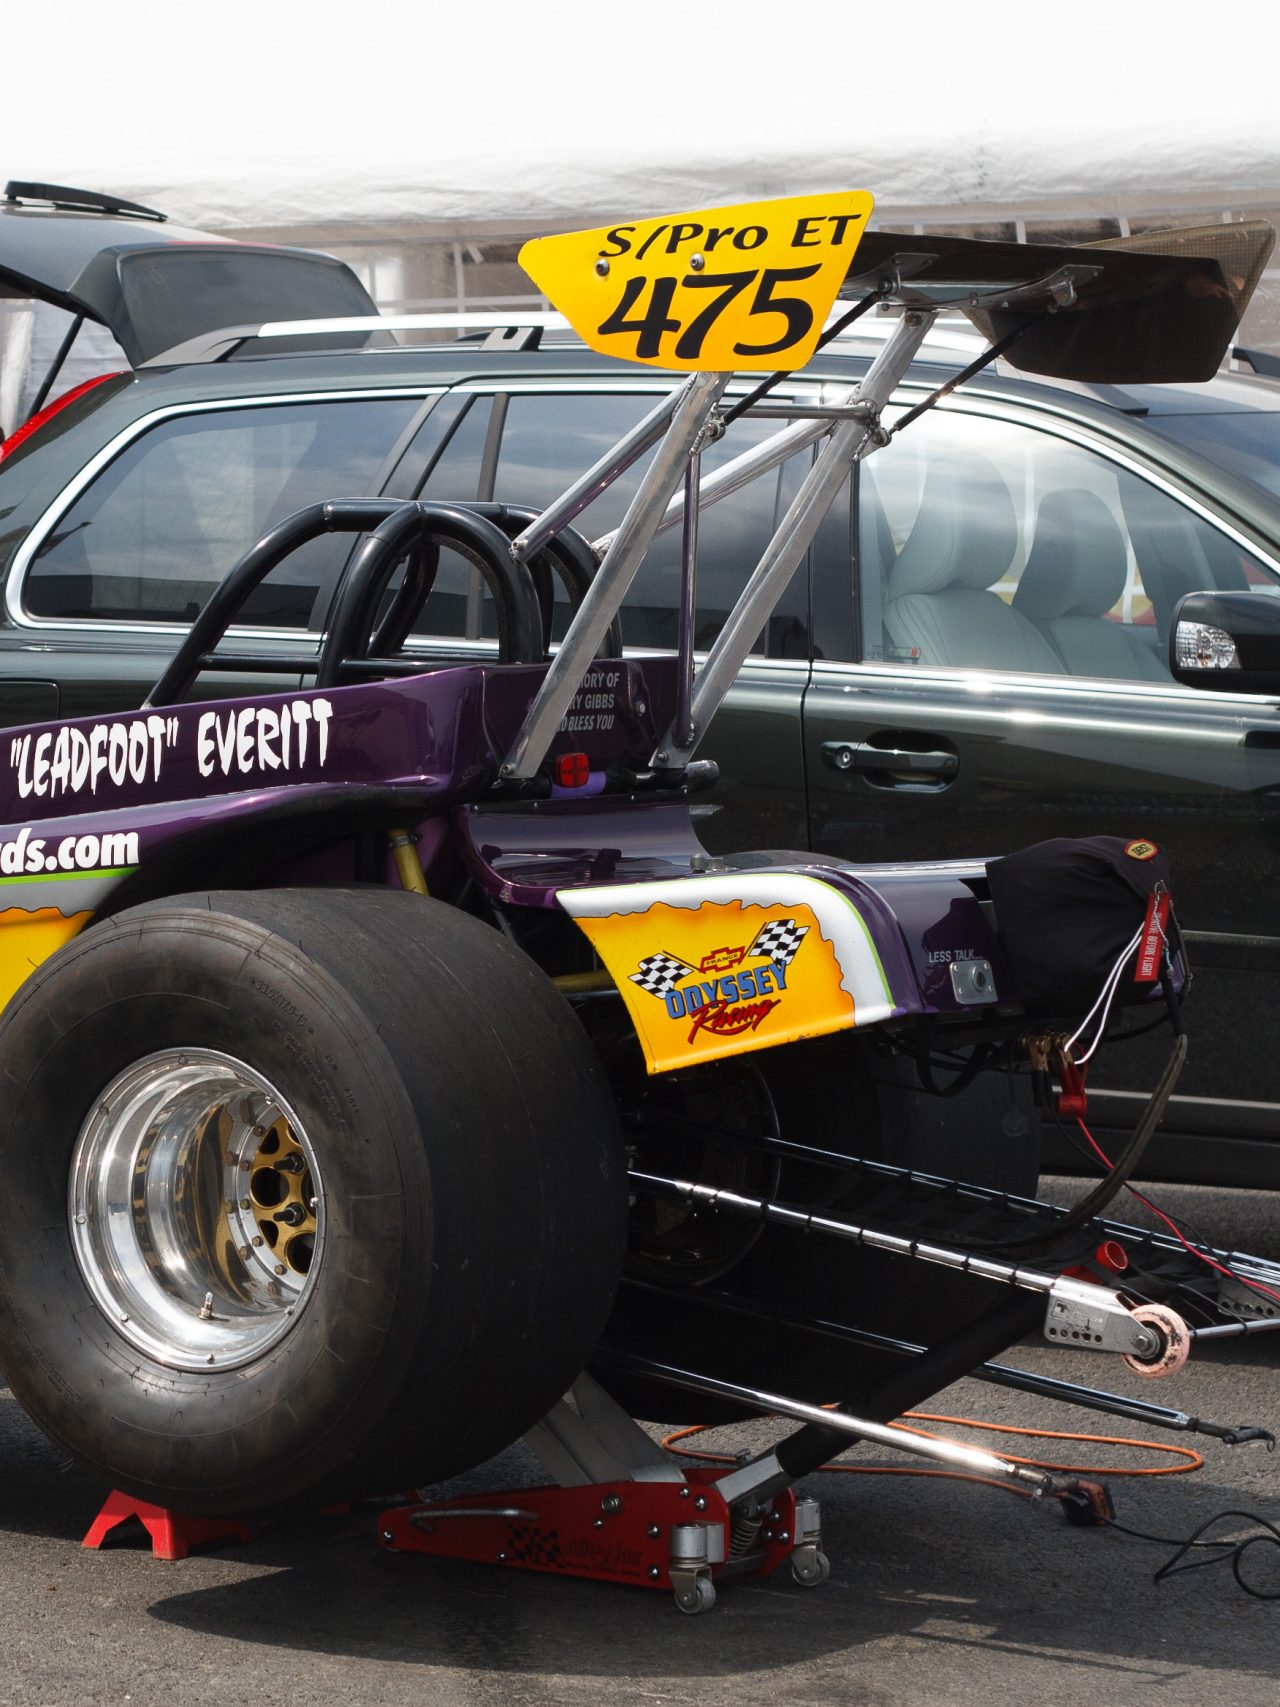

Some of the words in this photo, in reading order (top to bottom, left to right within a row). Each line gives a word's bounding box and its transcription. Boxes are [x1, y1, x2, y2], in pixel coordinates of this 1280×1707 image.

[598, 223, 768, 260] S/Pro
[790, 213, 862, 248] ET
[597, 262, 823, 360] 475
[606, 672, 620, 688] OF
[569, 694, 583, 710] RY
[584, 693, 615, 710] GIBBS
[568, 715, 595, 731] BLESS
[596, 714, 615, 731] YOU
[10, 715, 179, 799] "LEADFOOT"
[197, 698, 333, 776] EVERITT
[1145, 935, 1158, 956] BEFORE
[706, 953, 738, 966] FRANCE
[928, 950, 951, 963] LESS
[1141, 956, 1154, 976] FLIGHT
[665, 960, 787, 1019] ODYSSEY
[687, 999, 781, 1044] Racing
